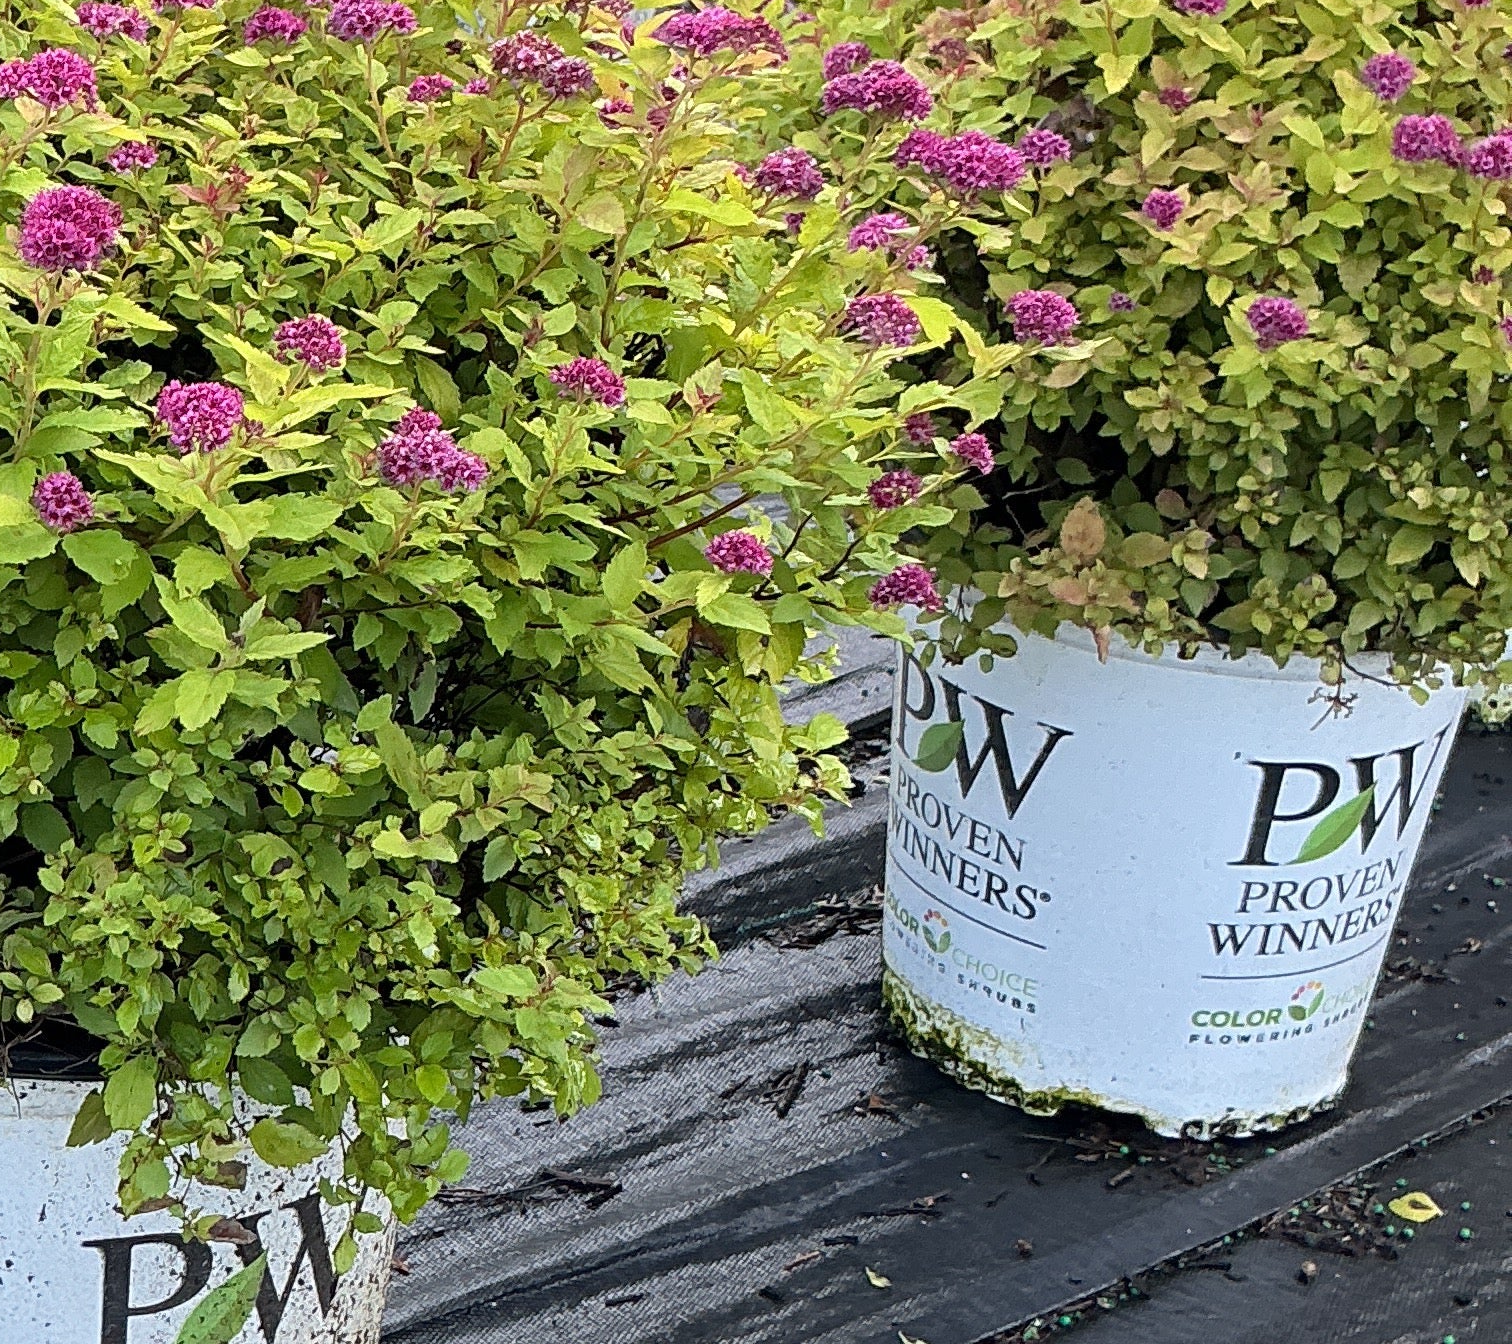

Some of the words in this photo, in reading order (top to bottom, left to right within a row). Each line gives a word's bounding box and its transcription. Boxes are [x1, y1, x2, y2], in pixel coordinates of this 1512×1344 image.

[897, 644, 1075, 820] PW
[897, 764, 1028, 873] PROVEN
[1226, 720, 1452, 867] PW
[1235, 850, 1403, 914] PROVEN
[952, 948, 1038, 999] CHOICE
[1189, 1023, 1314, 1045] FLOWERING
[1191, 1007, 1283, 1028] COLOR
